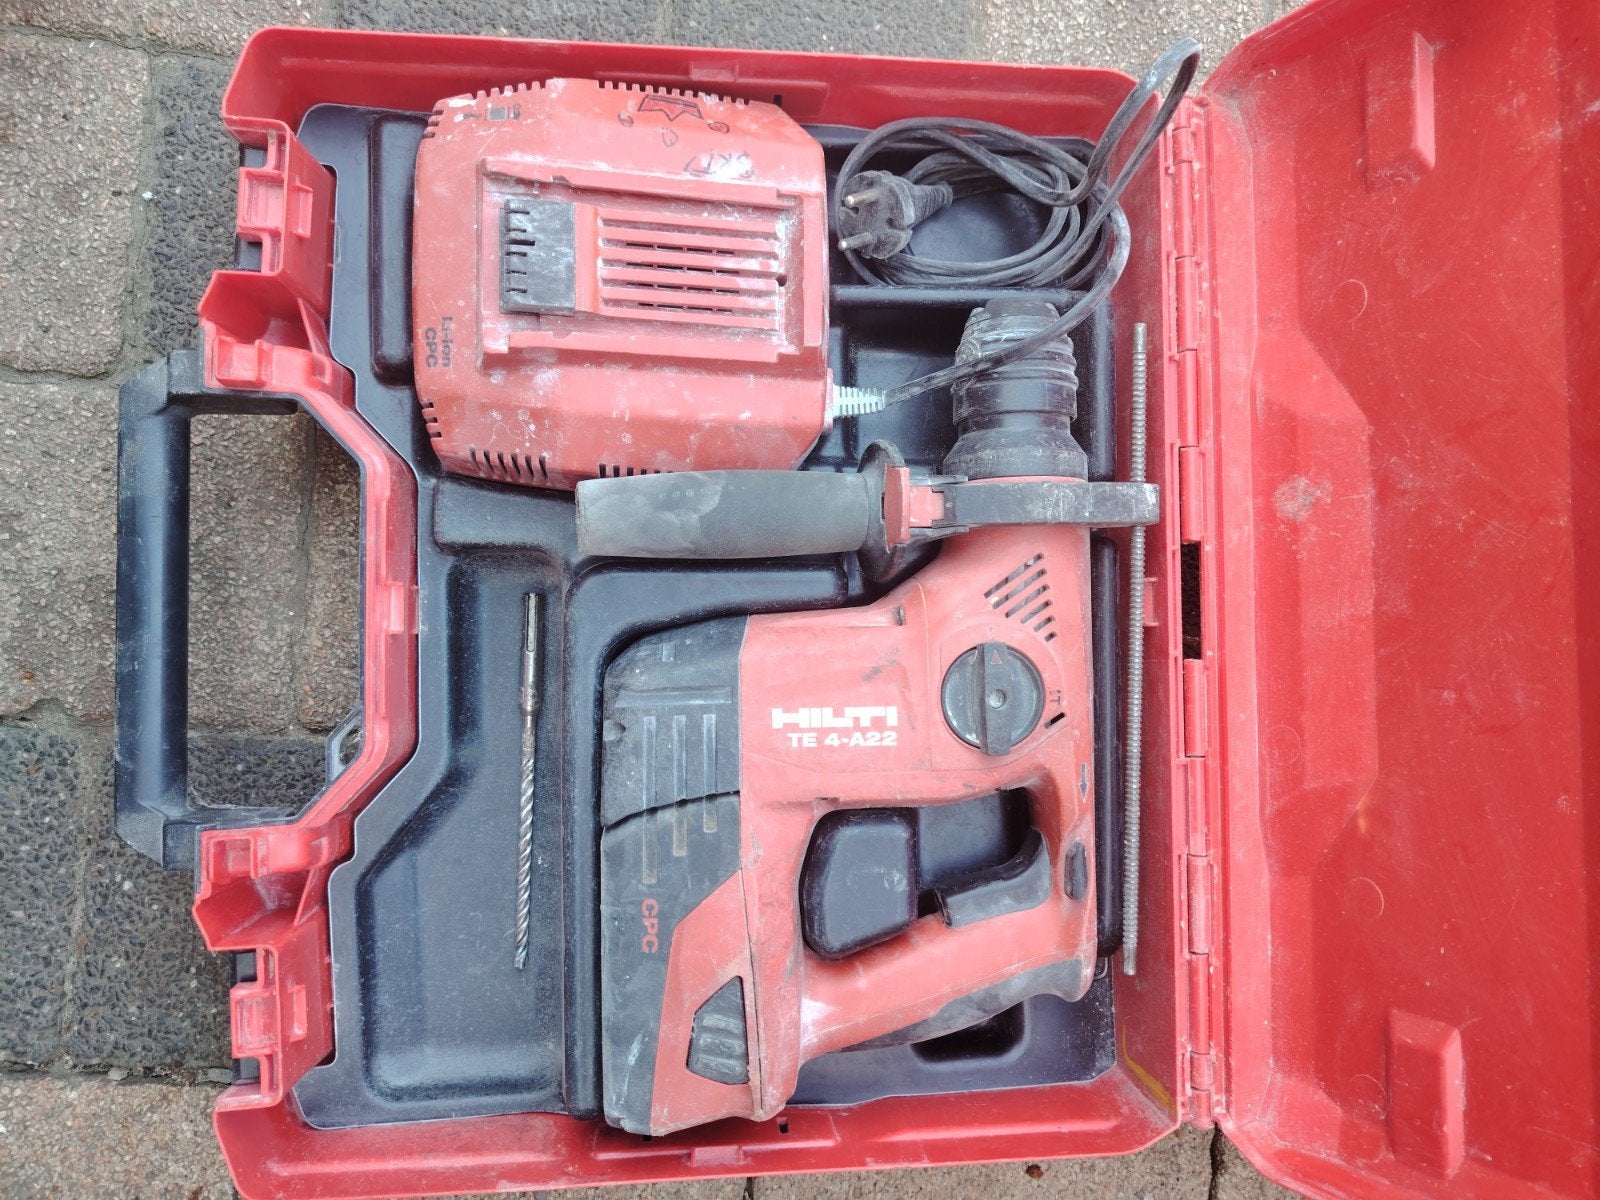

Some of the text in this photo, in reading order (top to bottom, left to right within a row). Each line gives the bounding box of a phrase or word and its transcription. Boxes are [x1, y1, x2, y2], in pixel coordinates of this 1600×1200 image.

[425, 327, 438, 368] CPC
[771, 706, 897, 728] HILTI
[786, 731, 897, 747] TE 4-A22
[641, 898, 658, 954] CPC
